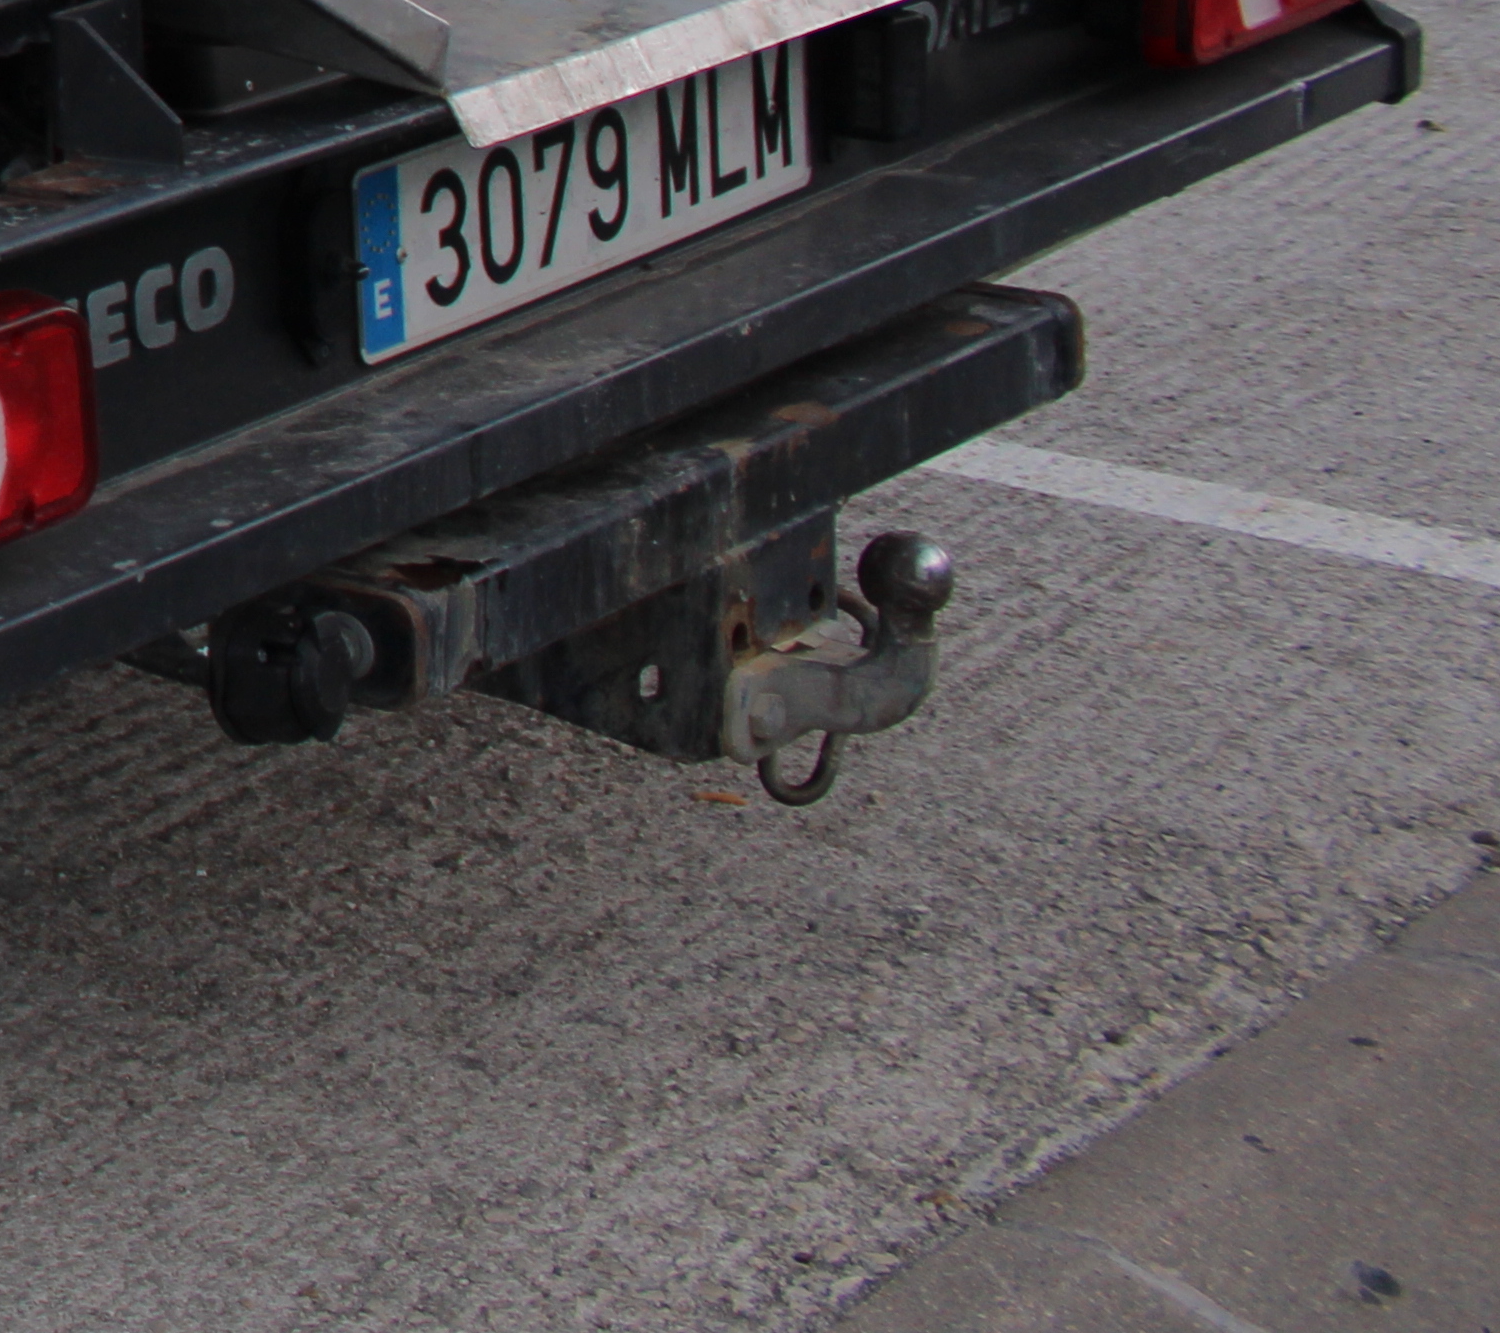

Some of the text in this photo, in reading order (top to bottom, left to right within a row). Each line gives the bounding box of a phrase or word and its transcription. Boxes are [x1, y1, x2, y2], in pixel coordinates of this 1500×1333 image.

[373, 38, 793, 321] E 3079 MLM
[64, 245, 235, 369] ECO
